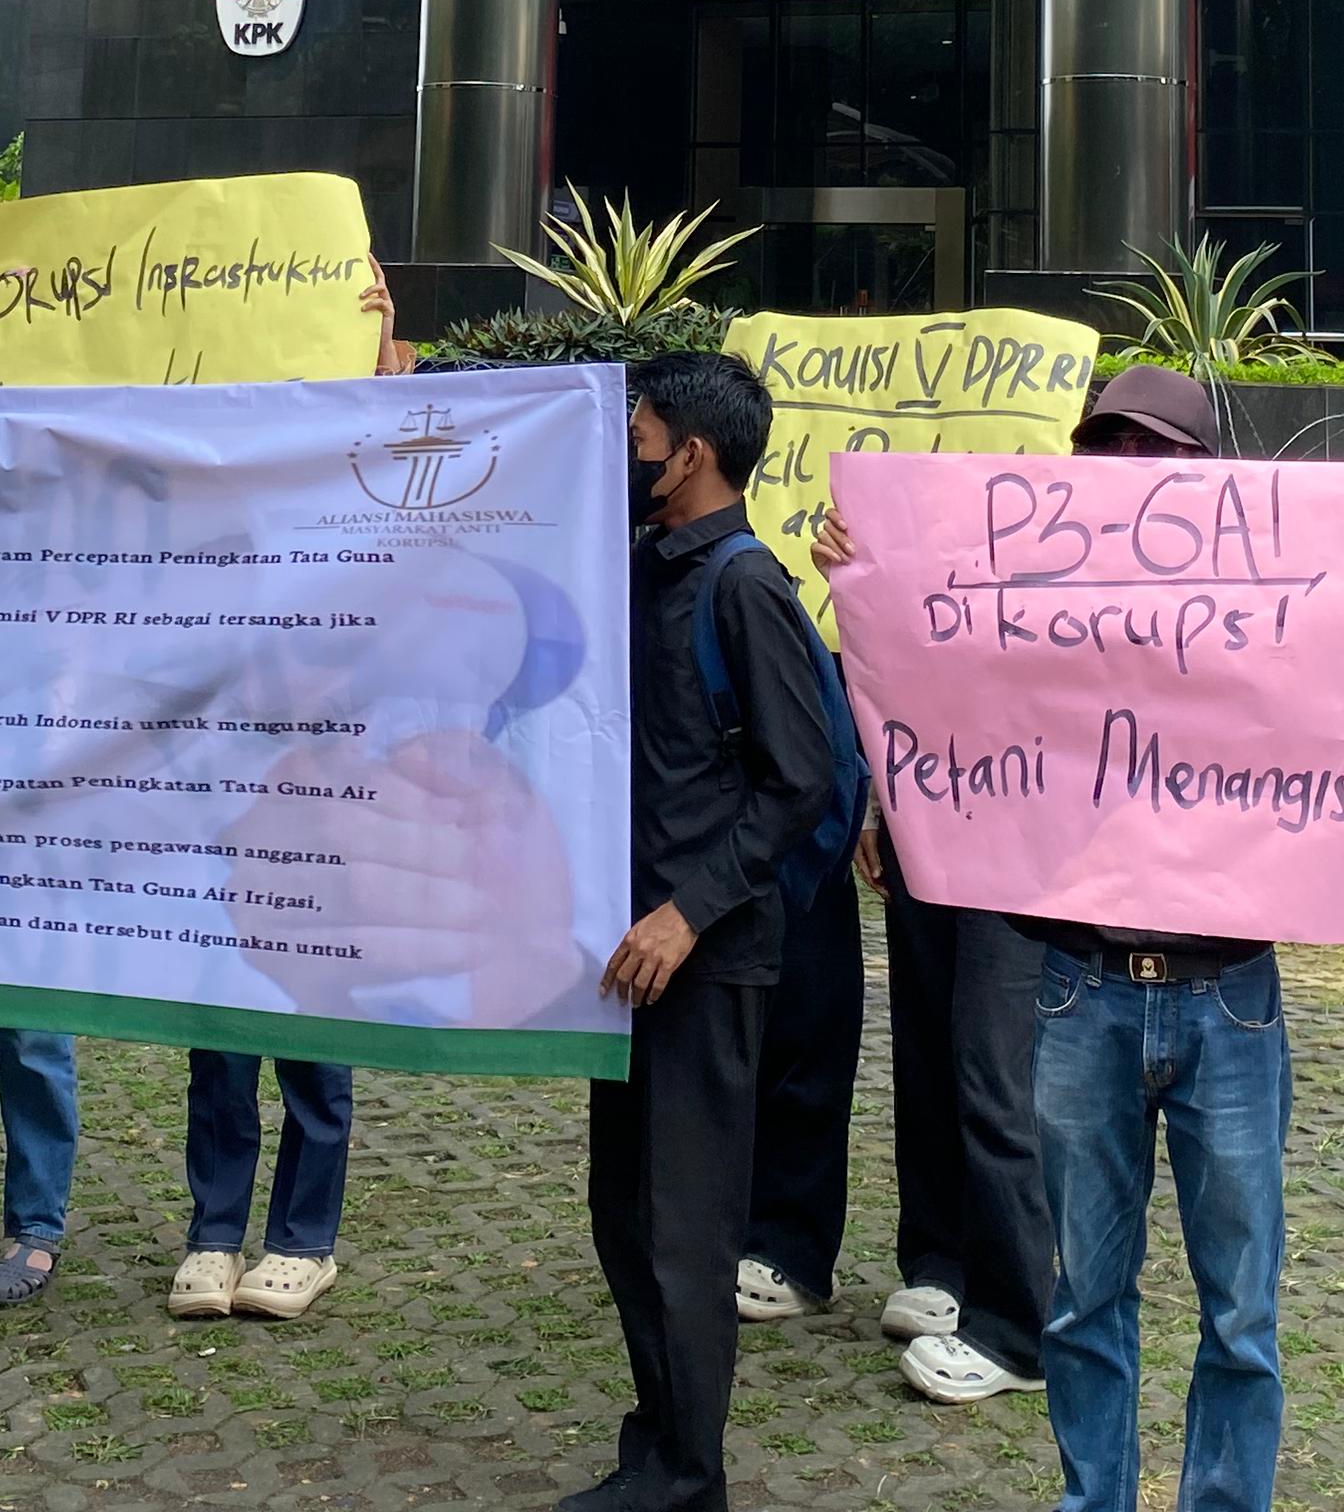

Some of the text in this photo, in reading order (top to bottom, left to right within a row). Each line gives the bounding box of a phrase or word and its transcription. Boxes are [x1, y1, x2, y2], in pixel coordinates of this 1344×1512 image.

[234, 22, 284, 45] KPK
[962, 334, 1045, 407] DPR
[750, 432, 814, 500] kil
[316, 510, 535, 525] ALIANSI MAHASISWA
[456, 524, 502, 535] ANTI
[40, 549, 153, 565] Percepatan
[158, 551, 281, 567] Peningkatan
[289, 551, 329, 563] Tata
[336, 550, 395, 563] Guna
[46, 610, 62, 622] V
[66, 612, 108, 625] DPR
[113, 613, 137, 625] RI
[143, 613, 211, 628] sebagai
[218, 613, 322, 629] tersangka
[329, 614, 377, 629] jika
[35, 714, 133, 730] Indonesia
[139, 718, 209, 730] untuk
[217, 719, 367, 736] mengungkap
[71, 775, 212, 792] Peningkatan
[219, 780, 269, 794] Tata
[277, 782, 334, 799] Guna
[340, 786, 378, 800] Air
[34, 834, 103, 849] proses
[110, 839, 238, 857] pengawasan
[244, 847, 346, 866] anggaran.
[88, 878, 135, 894] Tata
[142, 882, 196, 899] Guna
[202, 886, 239, 903] Air
[244, 890, 323, 912] Irigasi,
[28, 916, 78, 932] dana
[85, 922, 174, 941] tersebut
[178, 928, 289, 953] digunakan
[295, 942, 363, 960] untuk
